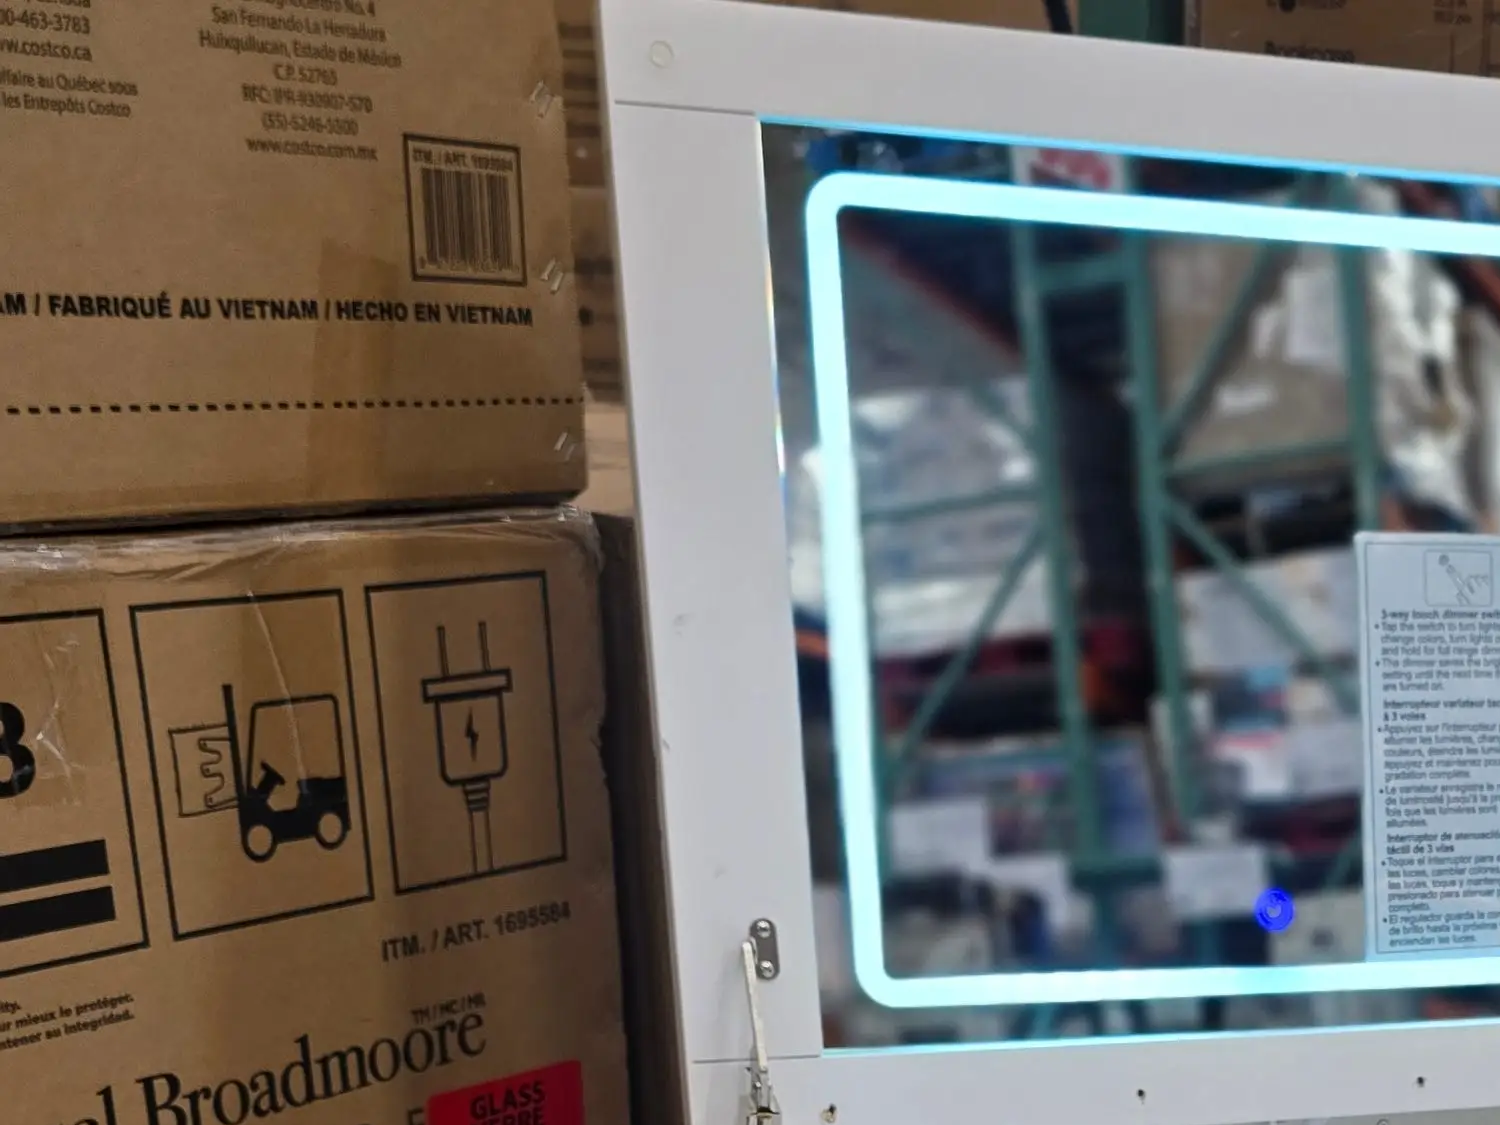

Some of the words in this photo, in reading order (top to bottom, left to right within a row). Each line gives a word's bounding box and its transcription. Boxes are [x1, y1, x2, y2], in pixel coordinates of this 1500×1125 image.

[48, 290, 172, 319] FABRIQUÉ
[179, 296, 212, 319] AU
[216, 297, 319, 321] VIETNAM
[336, 300, 408, 323] HECHO
[414, 302, 442, 323] EN
[446, 304, 533, 327] VIETNAM
[381, 933, 426, 963] ITM.
[443, 918, 489, 951] ART.
[471, 1080, 546, 1121] GLASS
